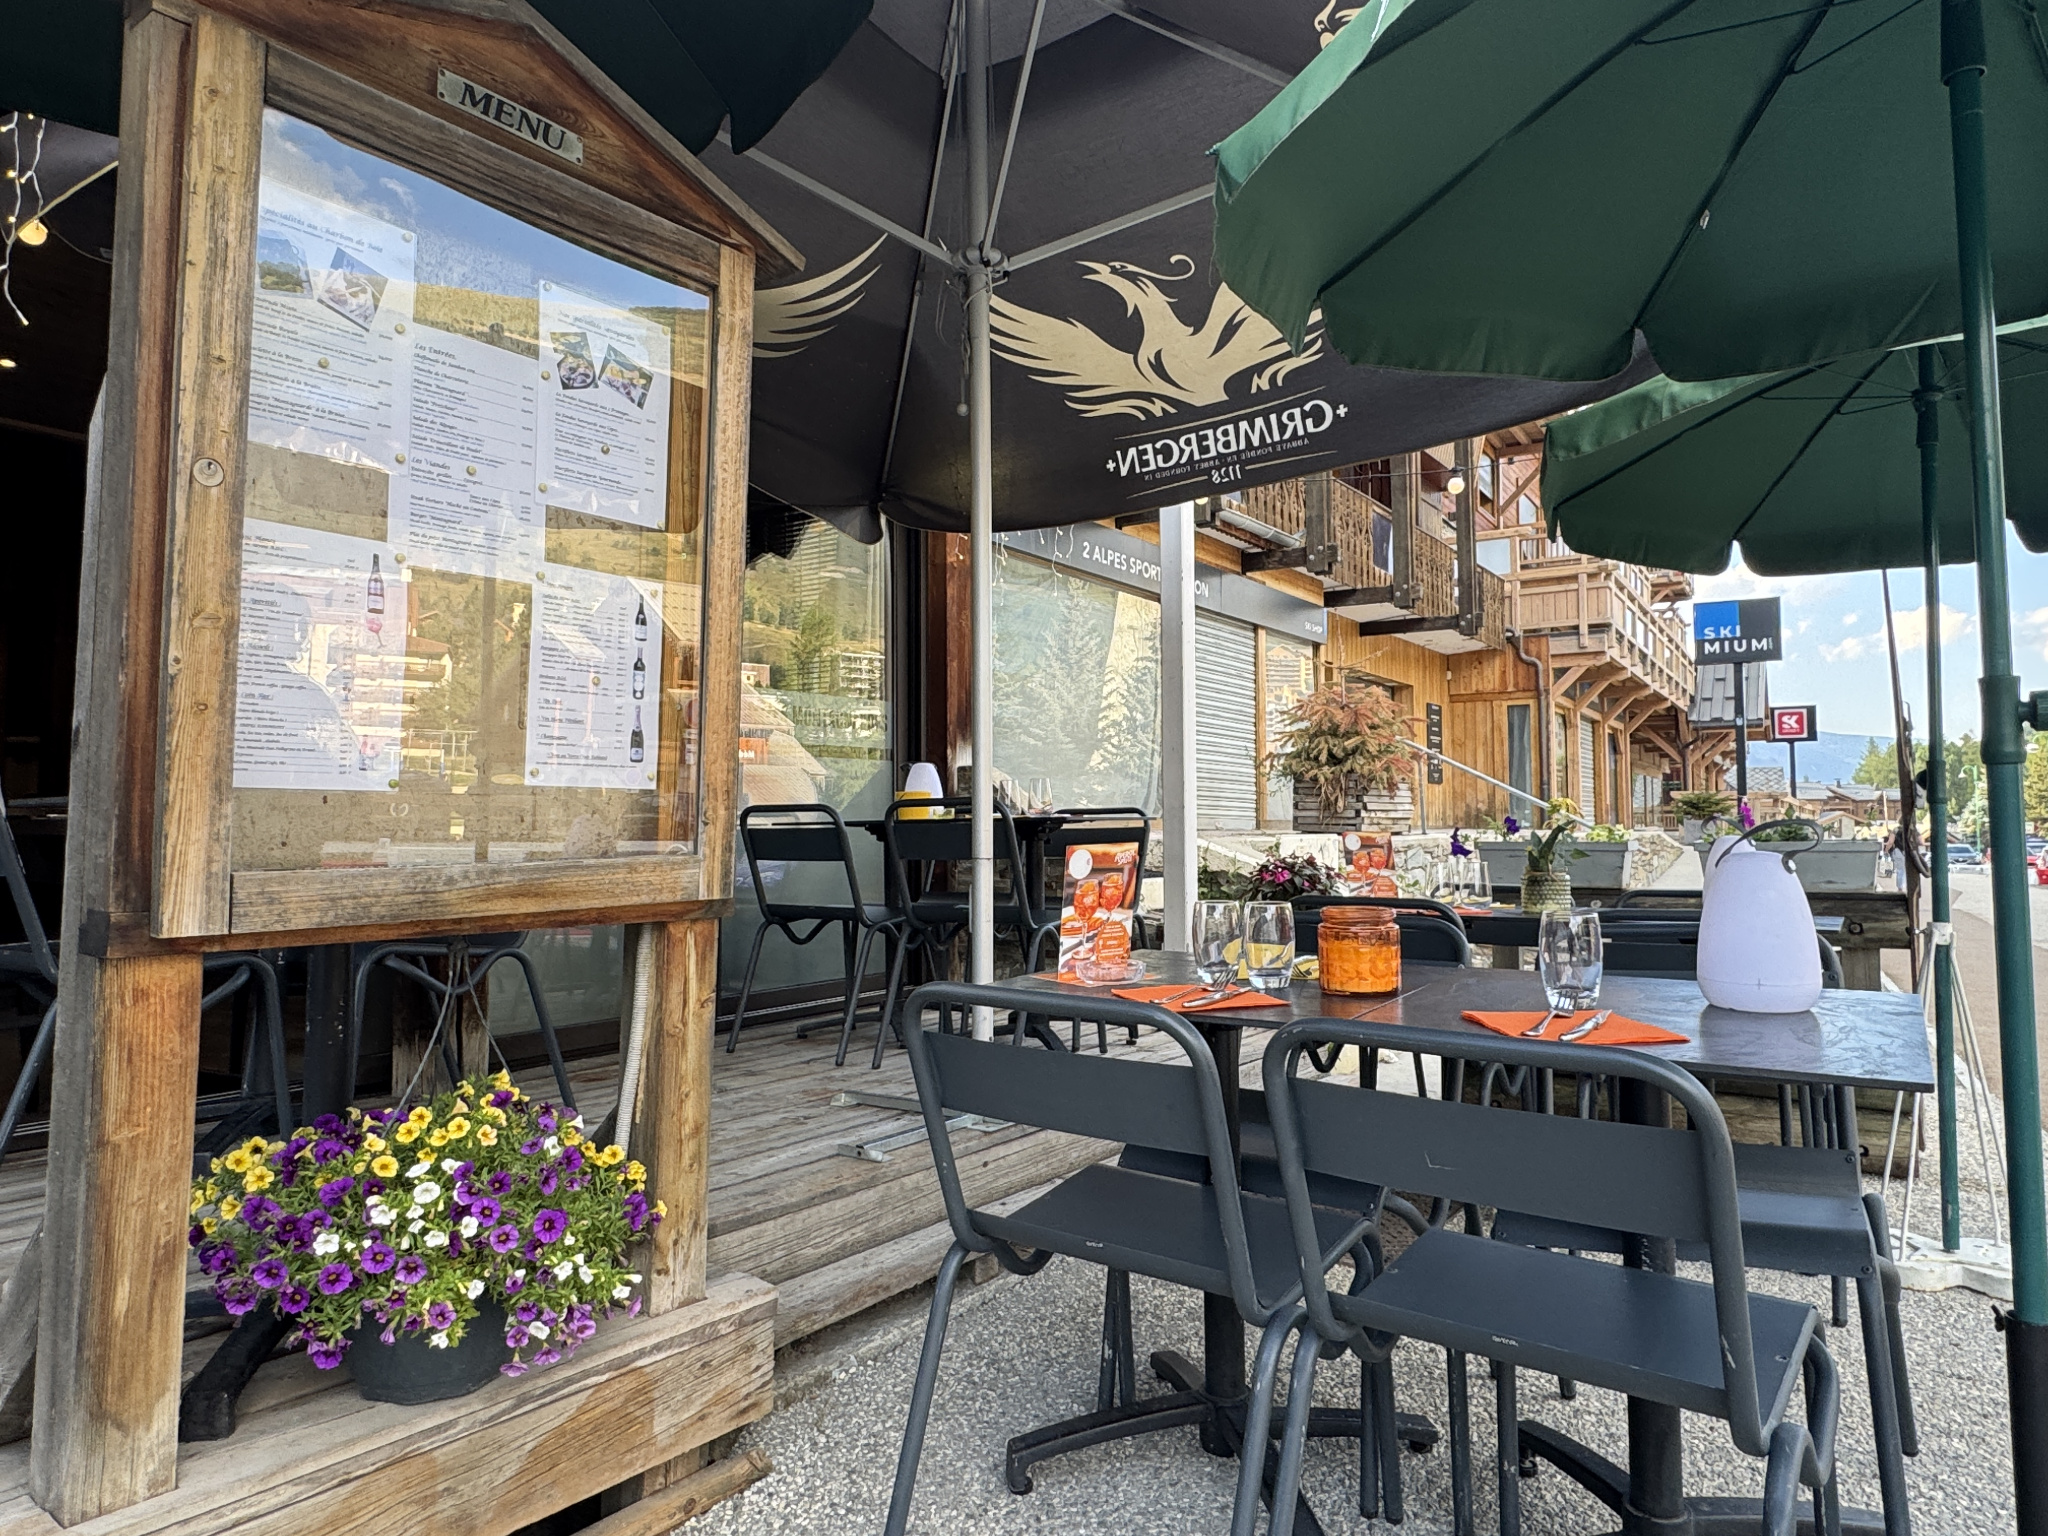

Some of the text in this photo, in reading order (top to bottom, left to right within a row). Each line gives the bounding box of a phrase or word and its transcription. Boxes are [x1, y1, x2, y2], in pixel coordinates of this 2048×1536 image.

[459, 82, 567, 150] MENU
[1083, 541, 1090, 559] 2
[1092, 545, 1127, 571] ALPES
[1703, 624, 1741, 640] SKI
[1704, 637, 1768, 655] MIUM
